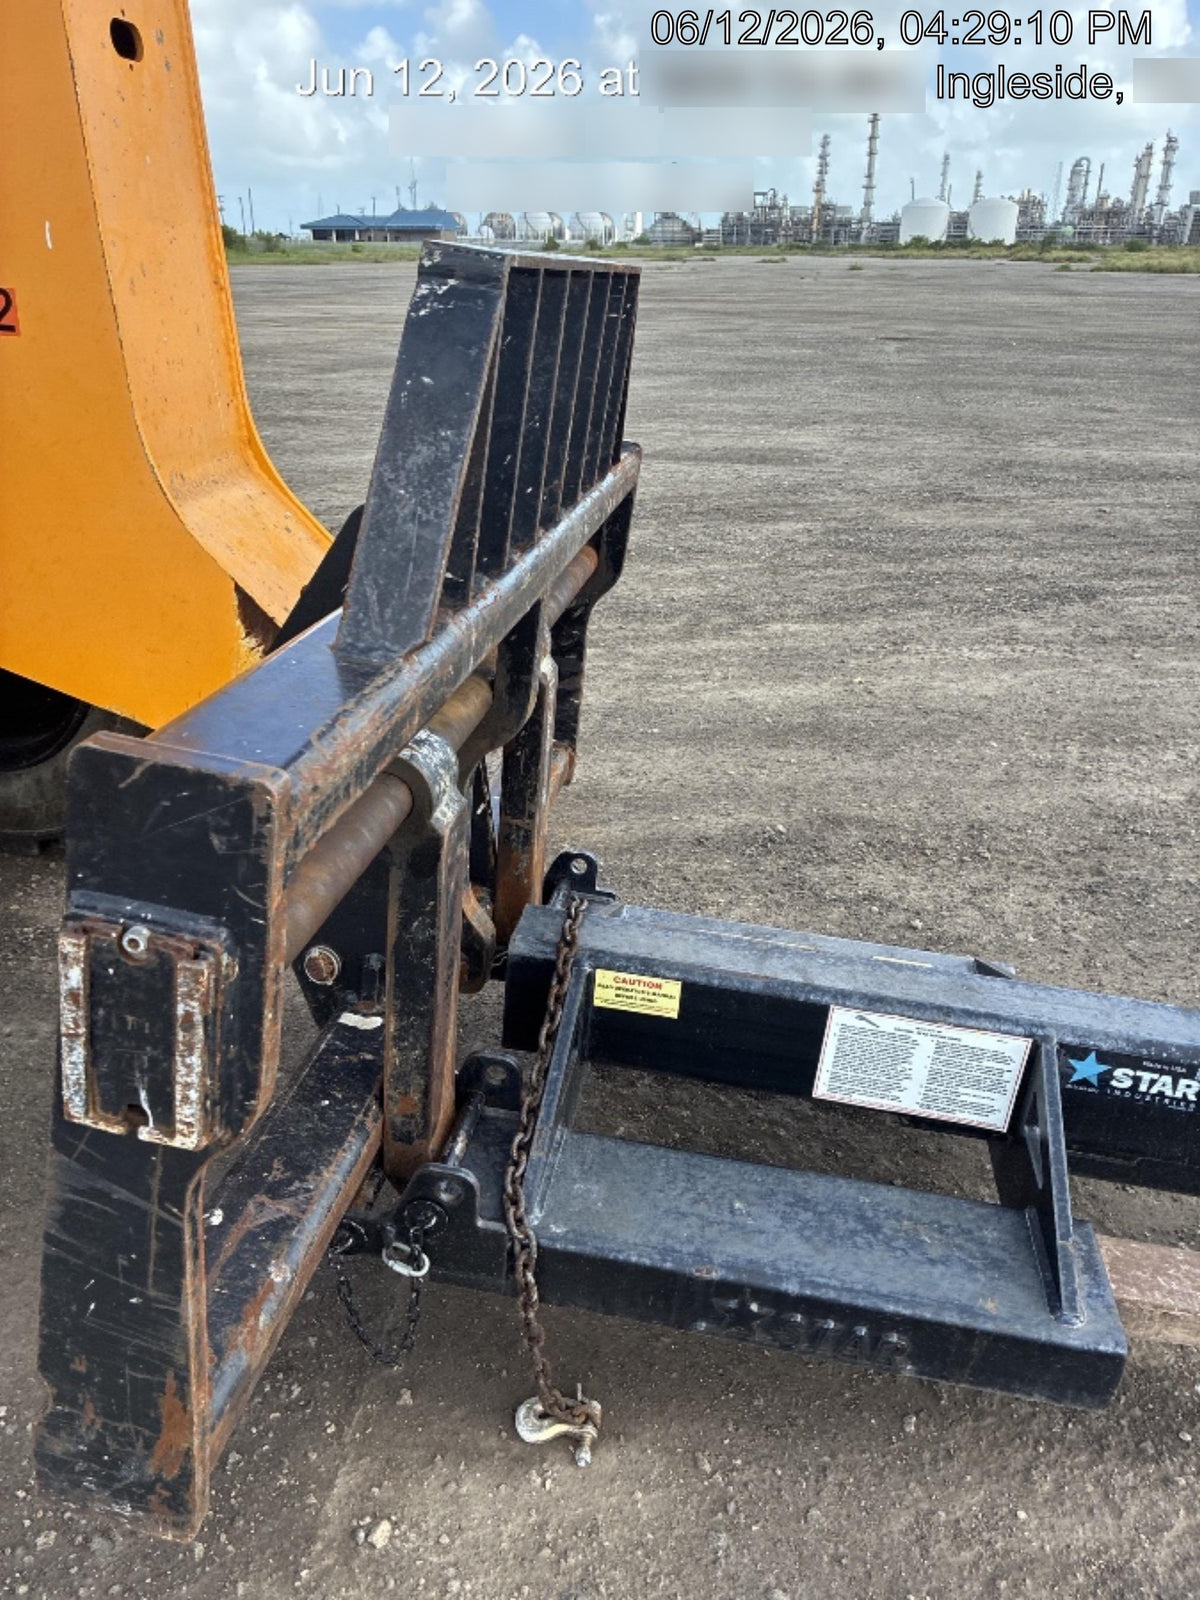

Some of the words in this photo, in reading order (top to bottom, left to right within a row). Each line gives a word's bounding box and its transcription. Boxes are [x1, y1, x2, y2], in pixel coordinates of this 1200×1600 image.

[613, 975, 663, 990] CAUTION
[1110, 1067, 1200, 1102] STAR
[1106, 1087, 1197, 1109] INDUSTRIES
